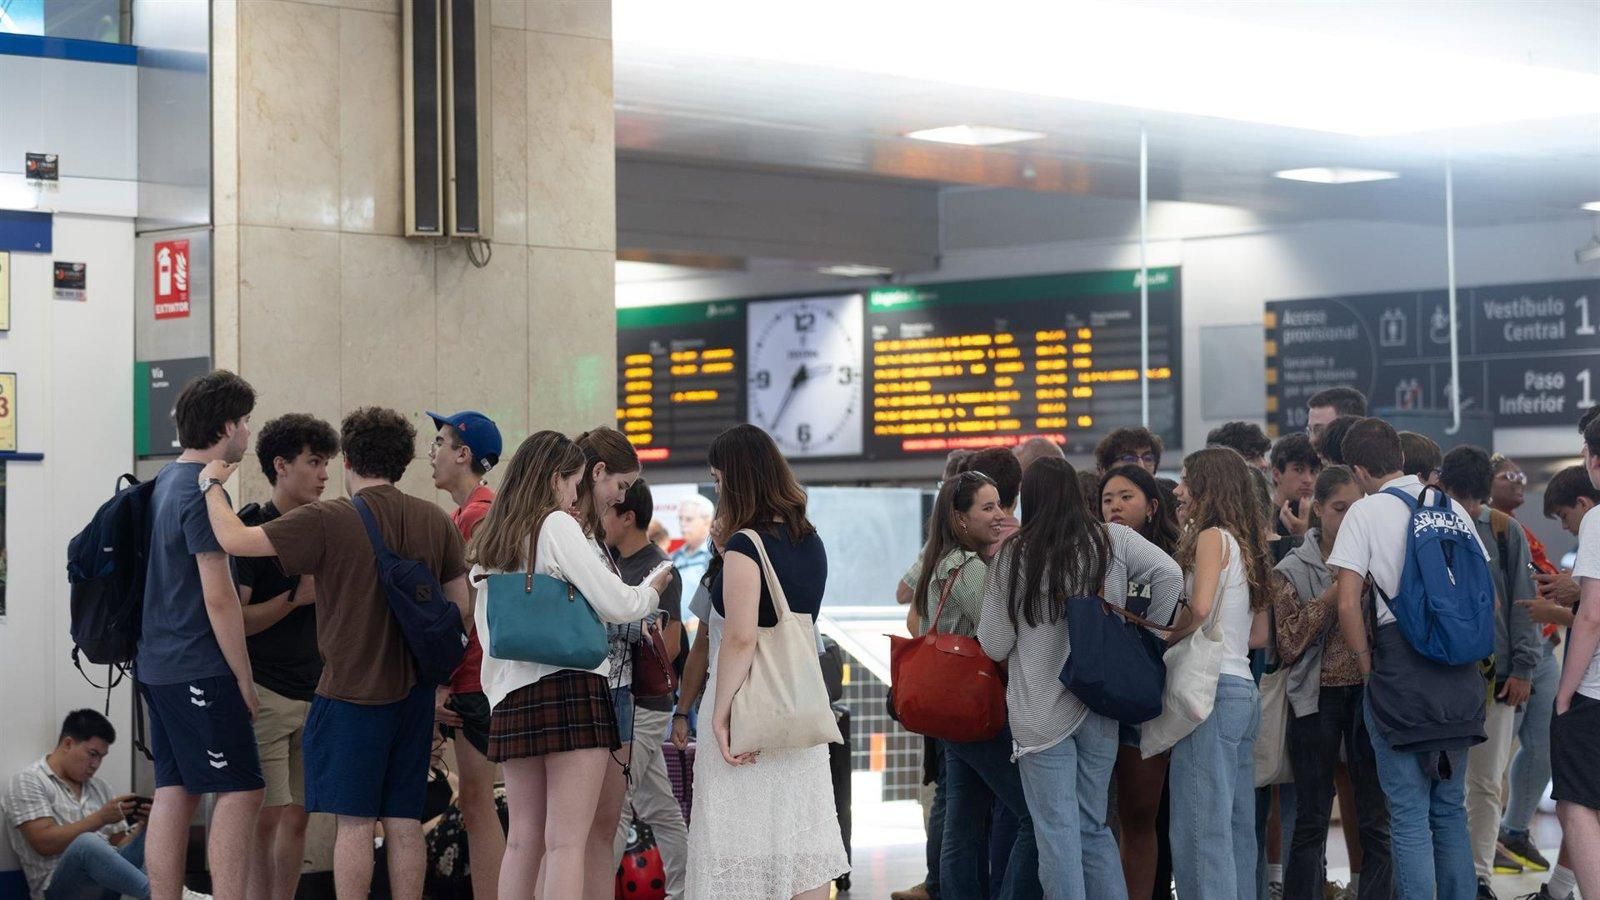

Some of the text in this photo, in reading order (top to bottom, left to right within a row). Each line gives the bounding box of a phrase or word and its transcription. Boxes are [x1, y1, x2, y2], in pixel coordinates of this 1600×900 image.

[155, 302, 190, 314] EXTINTOR
[1484, 296, 1565, 319] Vestíbulo
[794, 312, 815, 332] 12
[1283, 310, 1327, 326] Acceso
[1283, 323, 1358, 346] provisional
[1503, 319, 1566, 341] Central
[756, 370, 770, 389] 9
[839, 367, 852, 385] 3
[1524, 368, 1597, 409] Paso 1
[1499, 391, 1566, 415] Inferior
[797, 424, 811, 443] 6
